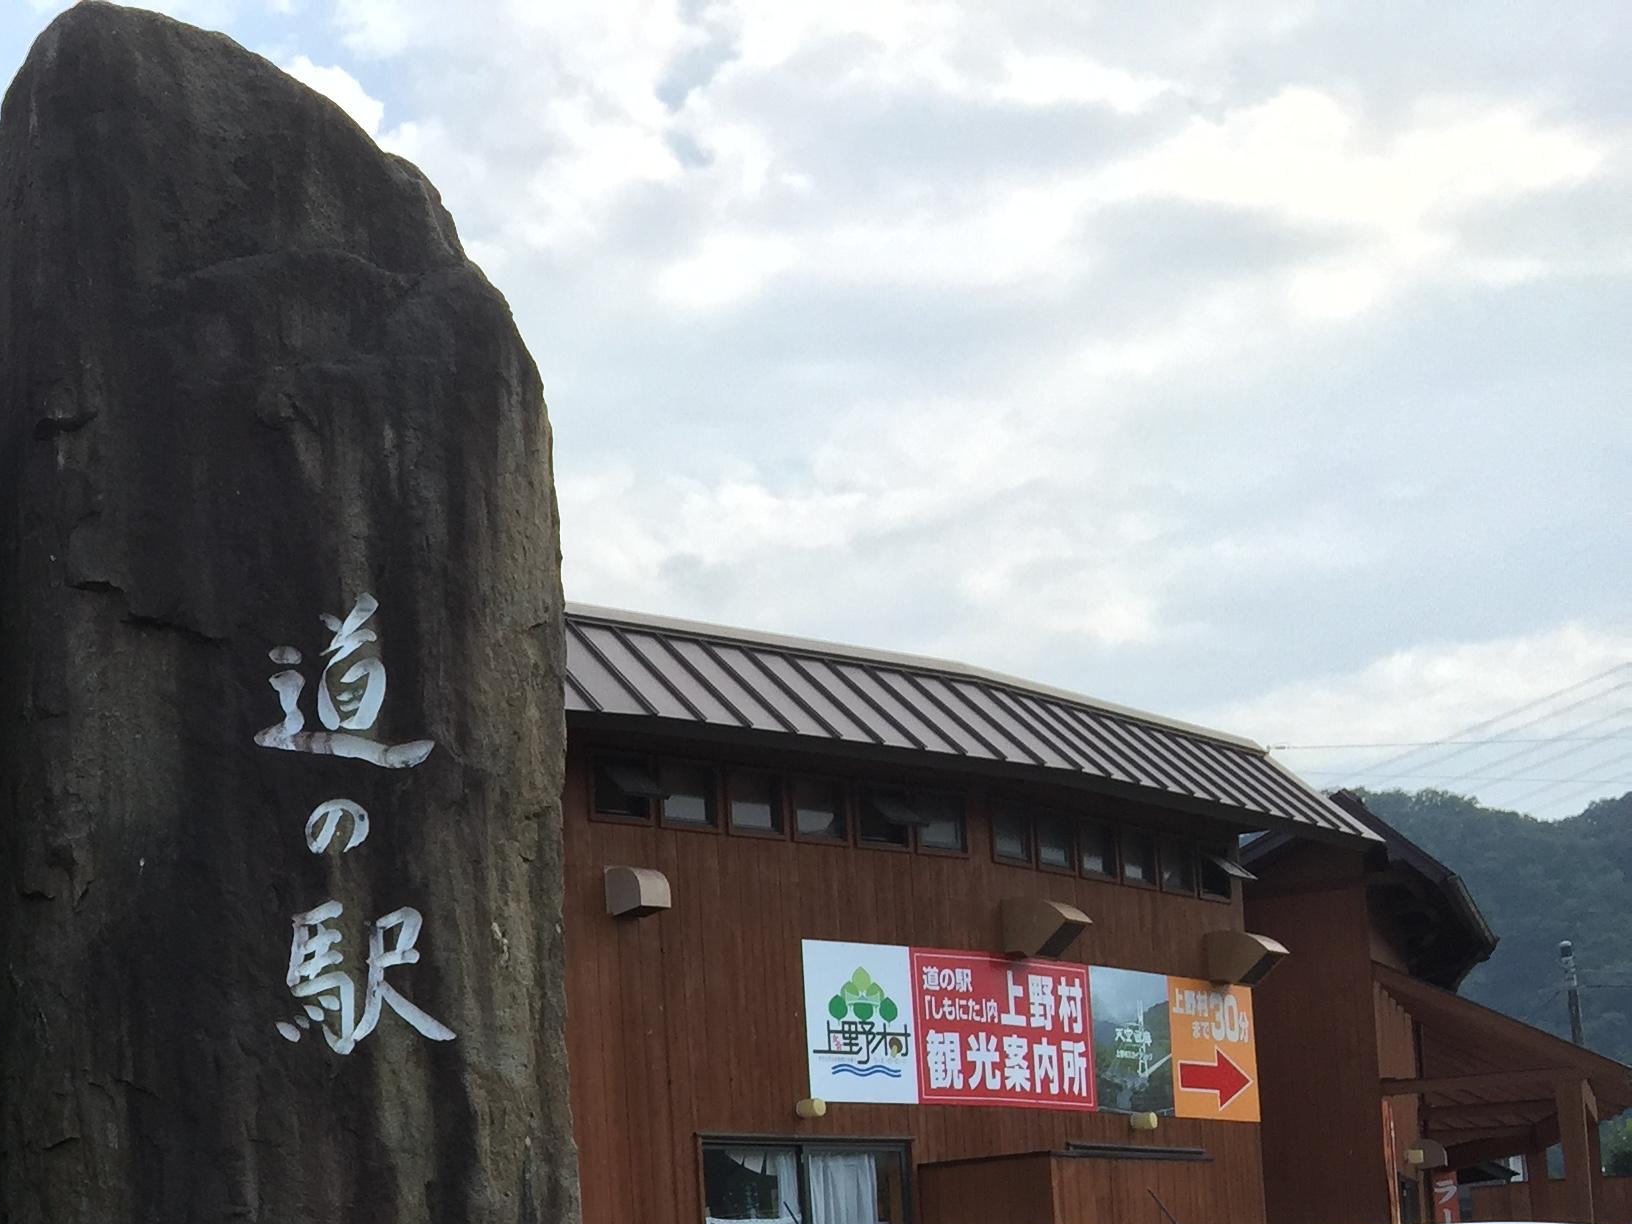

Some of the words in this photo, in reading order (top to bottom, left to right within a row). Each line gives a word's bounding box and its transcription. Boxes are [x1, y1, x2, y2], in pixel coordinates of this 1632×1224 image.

[254, 593, 456, 1056] 道の駅
[922, 966, 973, 993] 道の駅
[1001, 970, 1083, 1034] 上野村
[1172, 988, 1209, 1017] 上野村
[813, 1020, 911, 1065] 上野村
[926, 1029, 1087, 1096] 観光案内所
